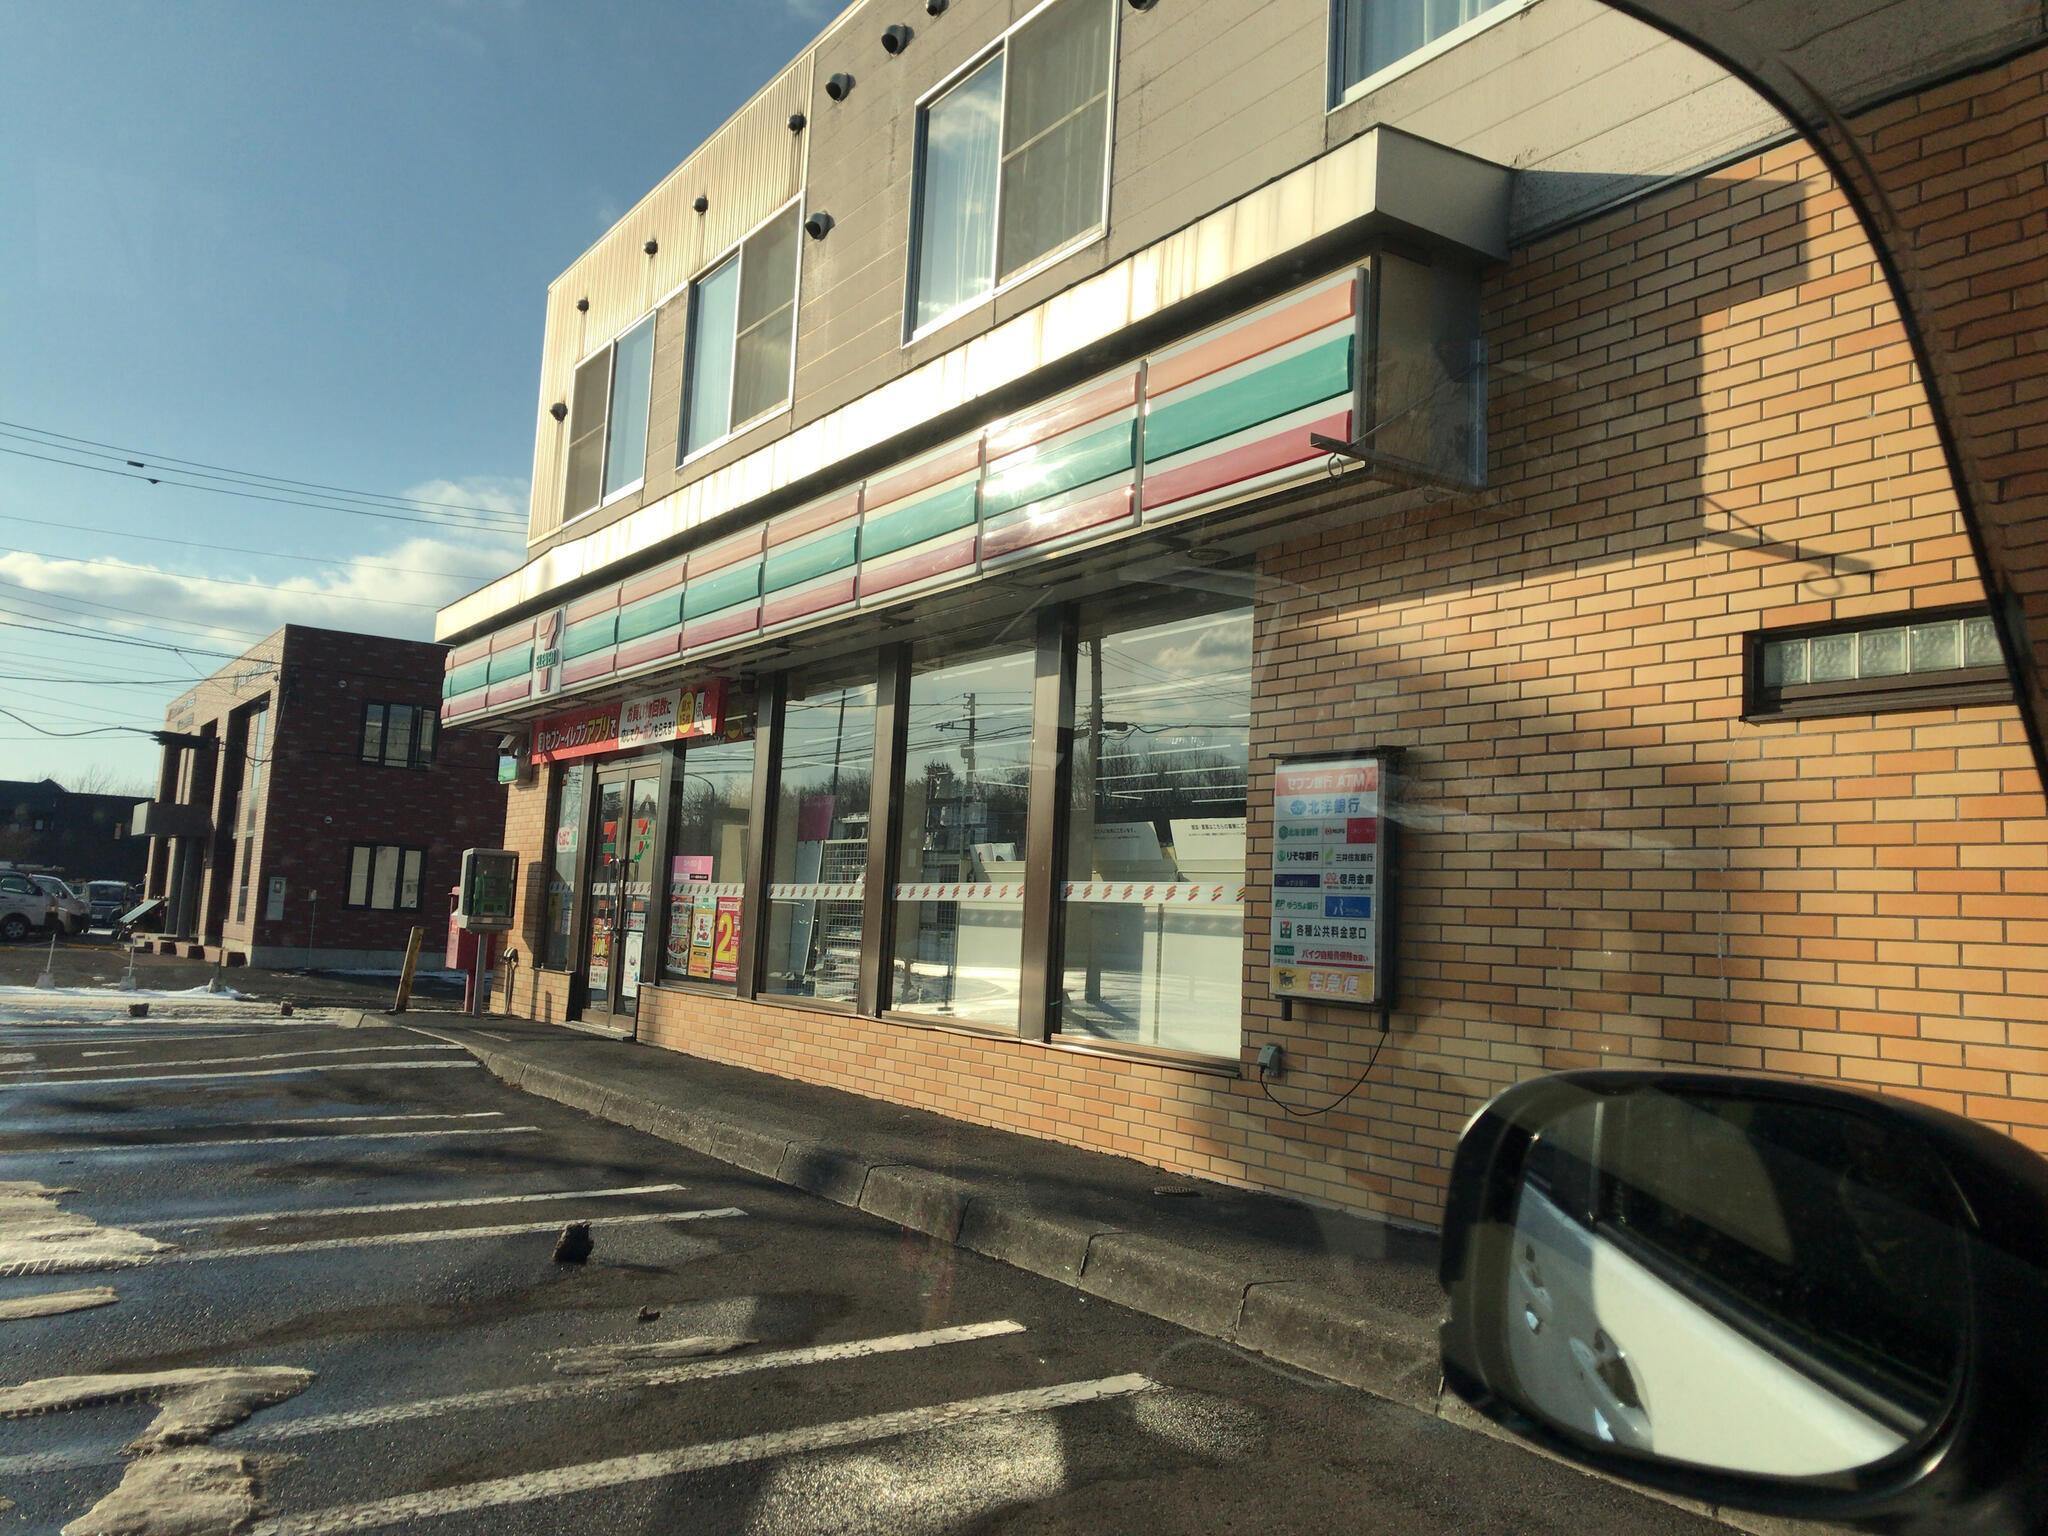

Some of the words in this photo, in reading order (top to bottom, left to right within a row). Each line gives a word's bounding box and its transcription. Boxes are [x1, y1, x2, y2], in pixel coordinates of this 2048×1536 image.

[1336, 773, 1365, 788] ATM
[1307, 797, 1360, 815] 北洋銀行
[1286, 850, 1319, 862] りそな銀行
[1335, 852, 1374, 863] 三井住友銀行
[1339, 873, 1374, 885] 信用金庫
[1286, 900, 1319, 911] ゆうちょ銀行
[1296, 923, 1367, 940] 各種公共料金窓口
[1309, 971, 1359, 994] 宅急便
